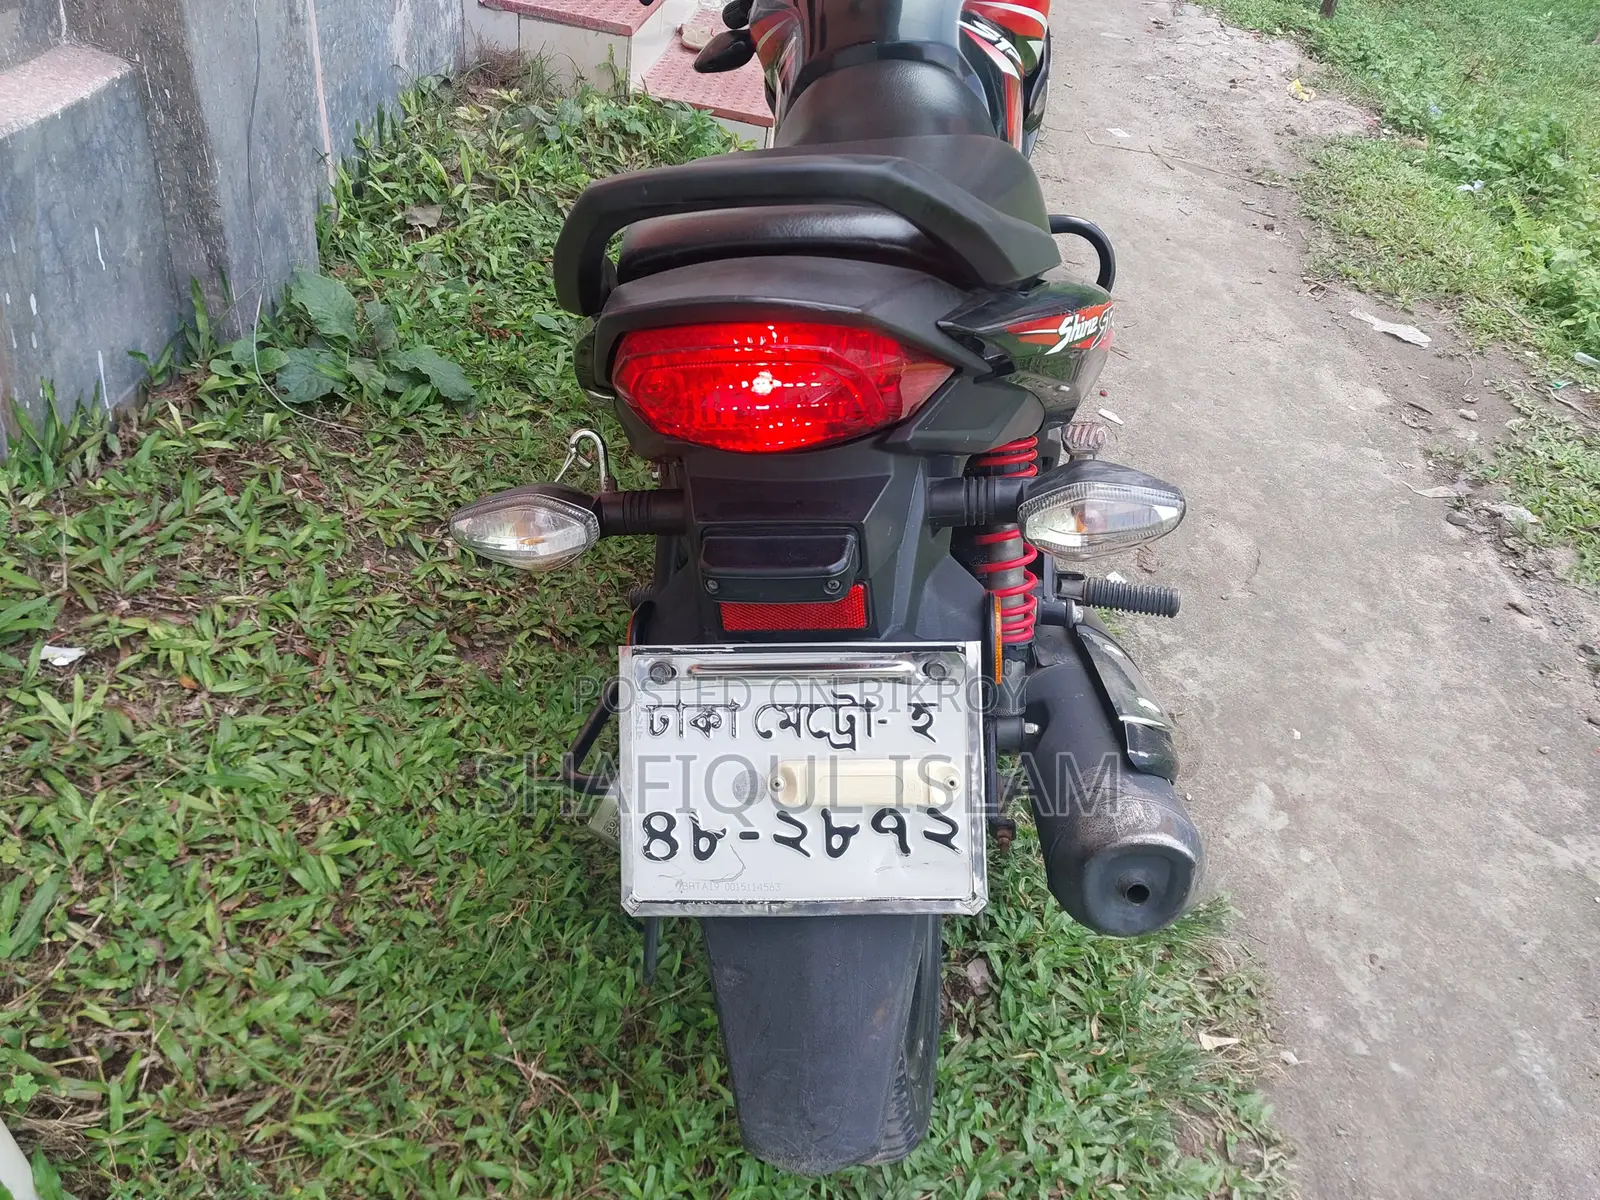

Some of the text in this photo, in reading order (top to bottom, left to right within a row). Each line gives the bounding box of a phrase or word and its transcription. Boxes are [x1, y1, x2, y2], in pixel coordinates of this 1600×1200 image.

[1044, 313, 1099, 356] Shine
[645, 698, 741, 738] ঢাকা
[908, 702, 939, 743] হ
[642, 807, 963, 862] ৪৮-২৮৭২
